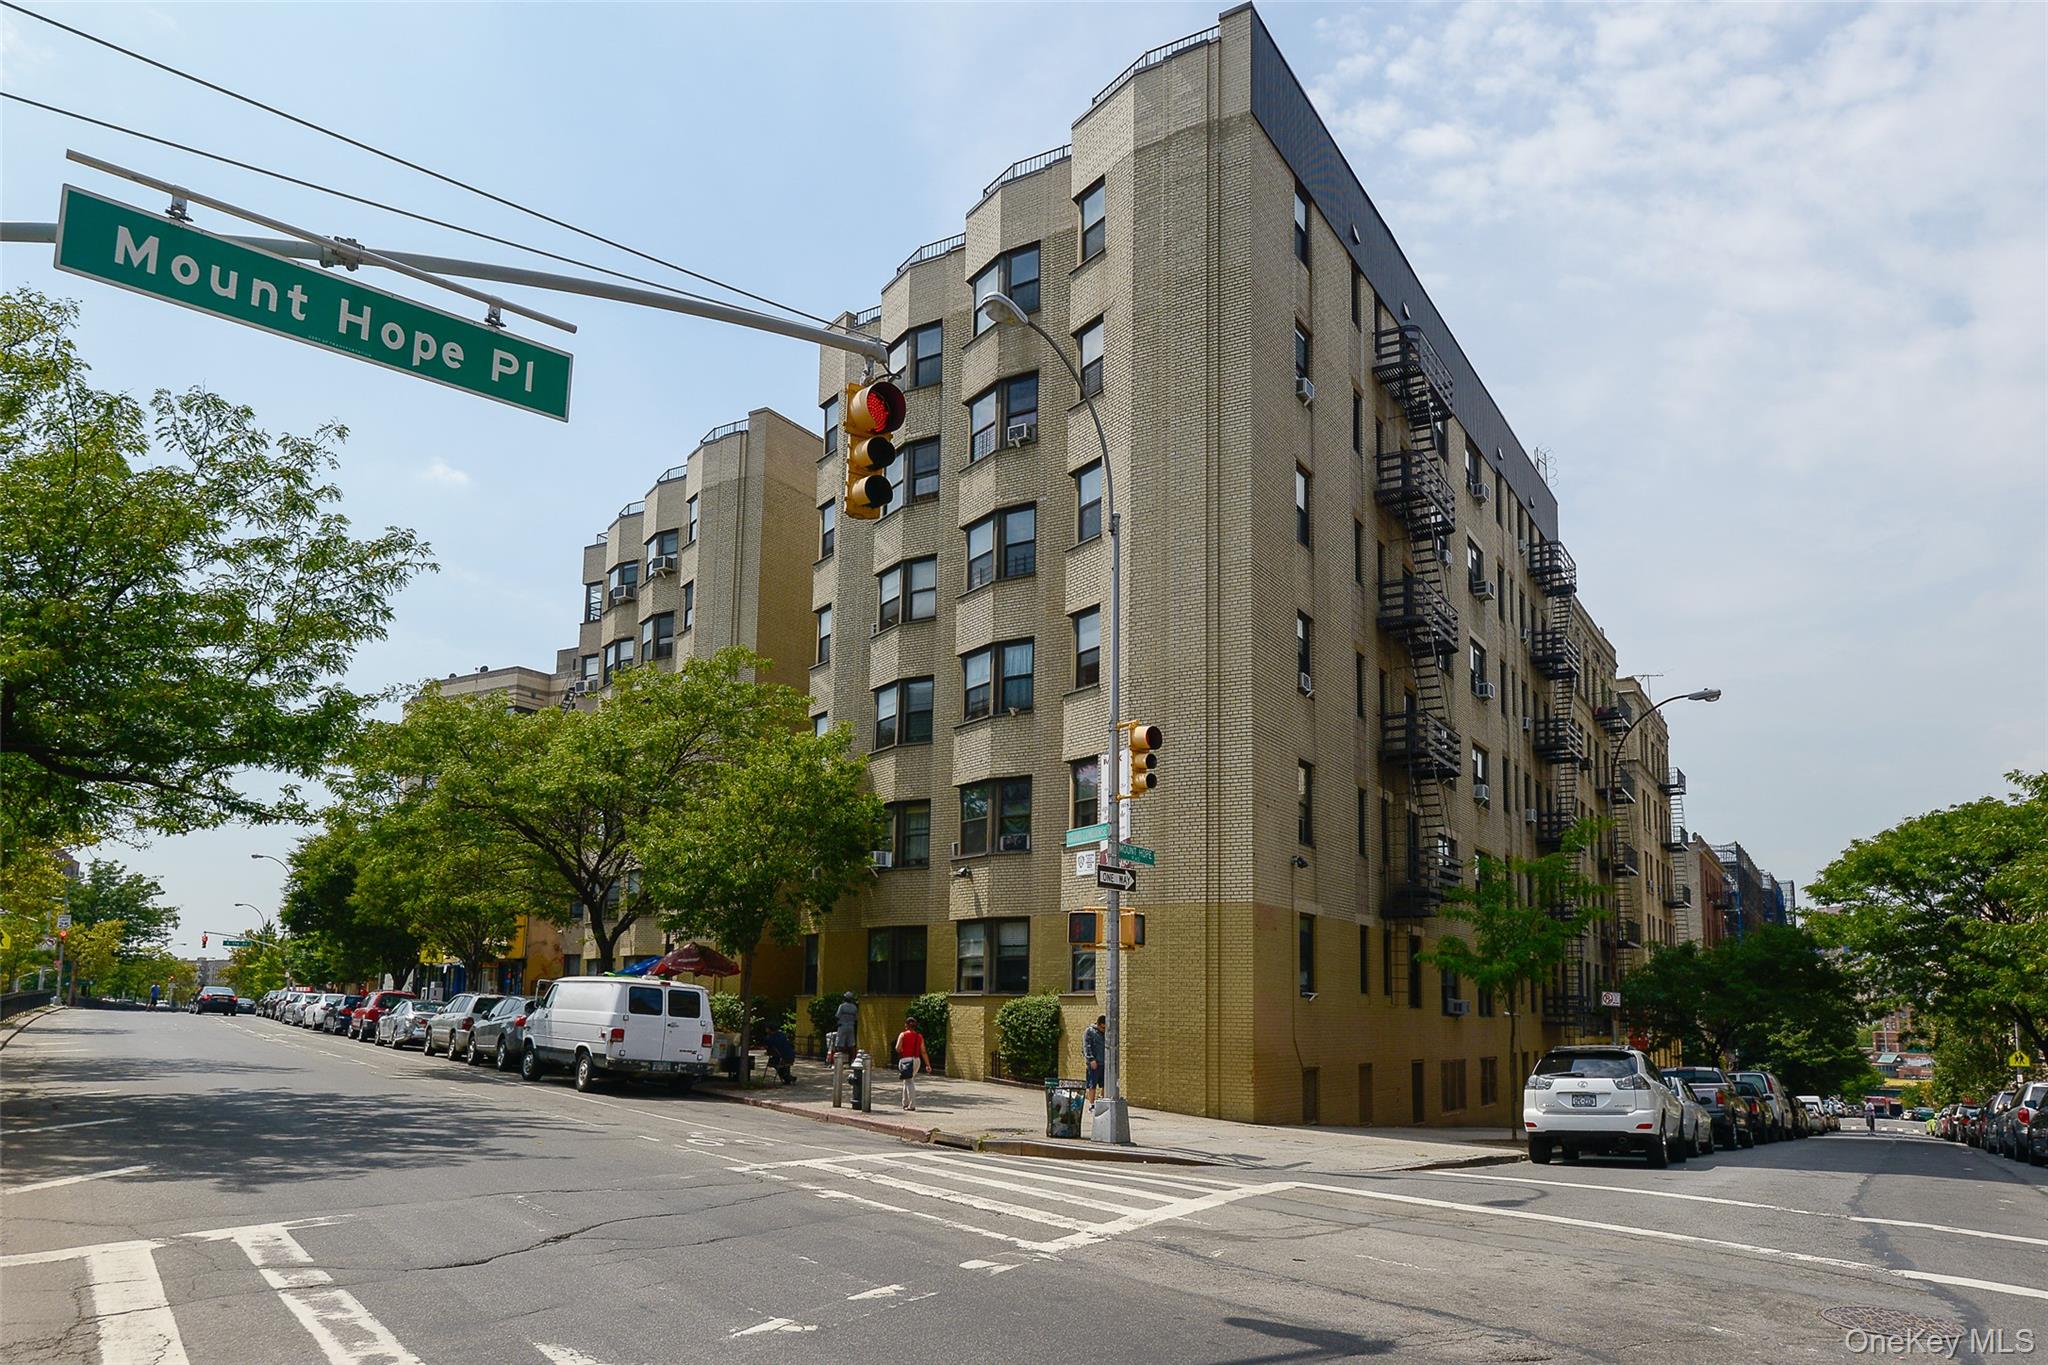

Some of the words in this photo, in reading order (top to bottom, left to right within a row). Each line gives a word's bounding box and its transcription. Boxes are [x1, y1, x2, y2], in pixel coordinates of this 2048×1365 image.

[114, 225, 308, 321] Mount
[338, 298, 465, 369] Hope
[491, 348, 534, 392] Pl
[1102, 872, 1114, 882] ONE
[1119, 875, 1131, 885] WAY
